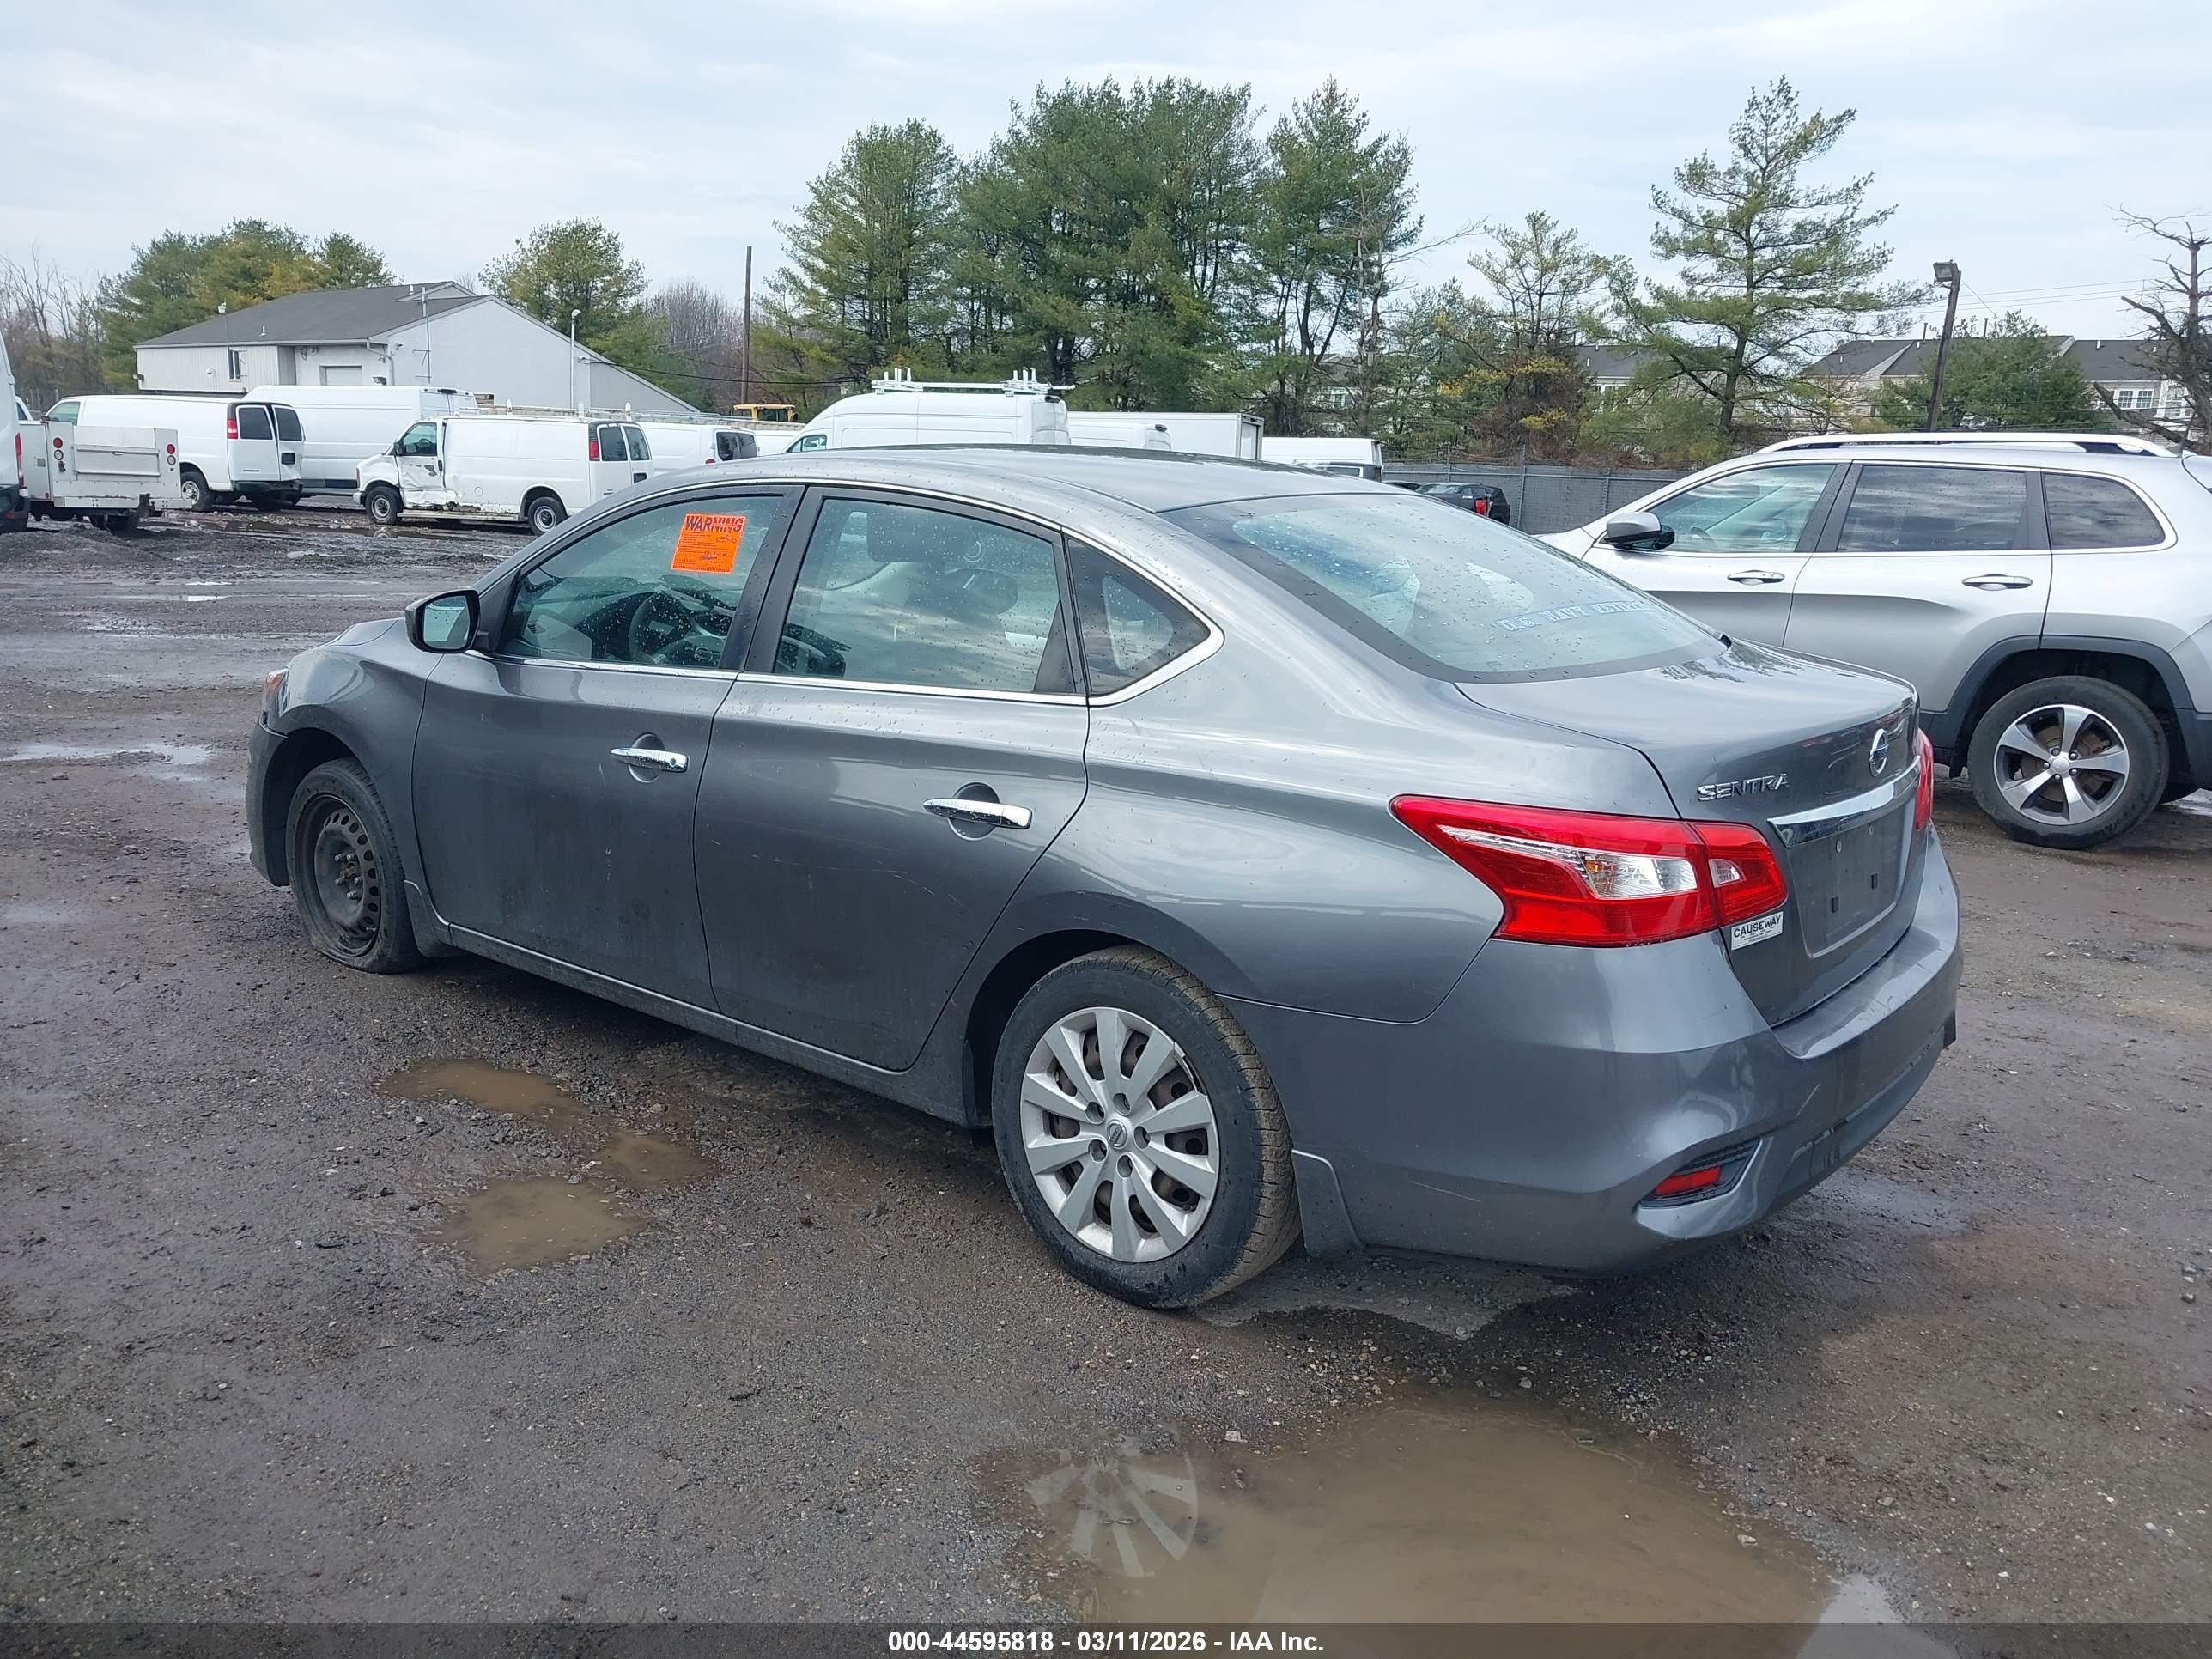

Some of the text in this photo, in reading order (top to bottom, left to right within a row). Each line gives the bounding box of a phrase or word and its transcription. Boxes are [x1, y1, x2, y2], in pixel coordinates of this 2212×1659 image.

[685, 515, 744, 532] WARNING
[1540, 606, 1591, 623] NAVY
[1697, 773, 1790, 802] SENTRA
[1734, 915, 1782, 938] CAUSEWAY
